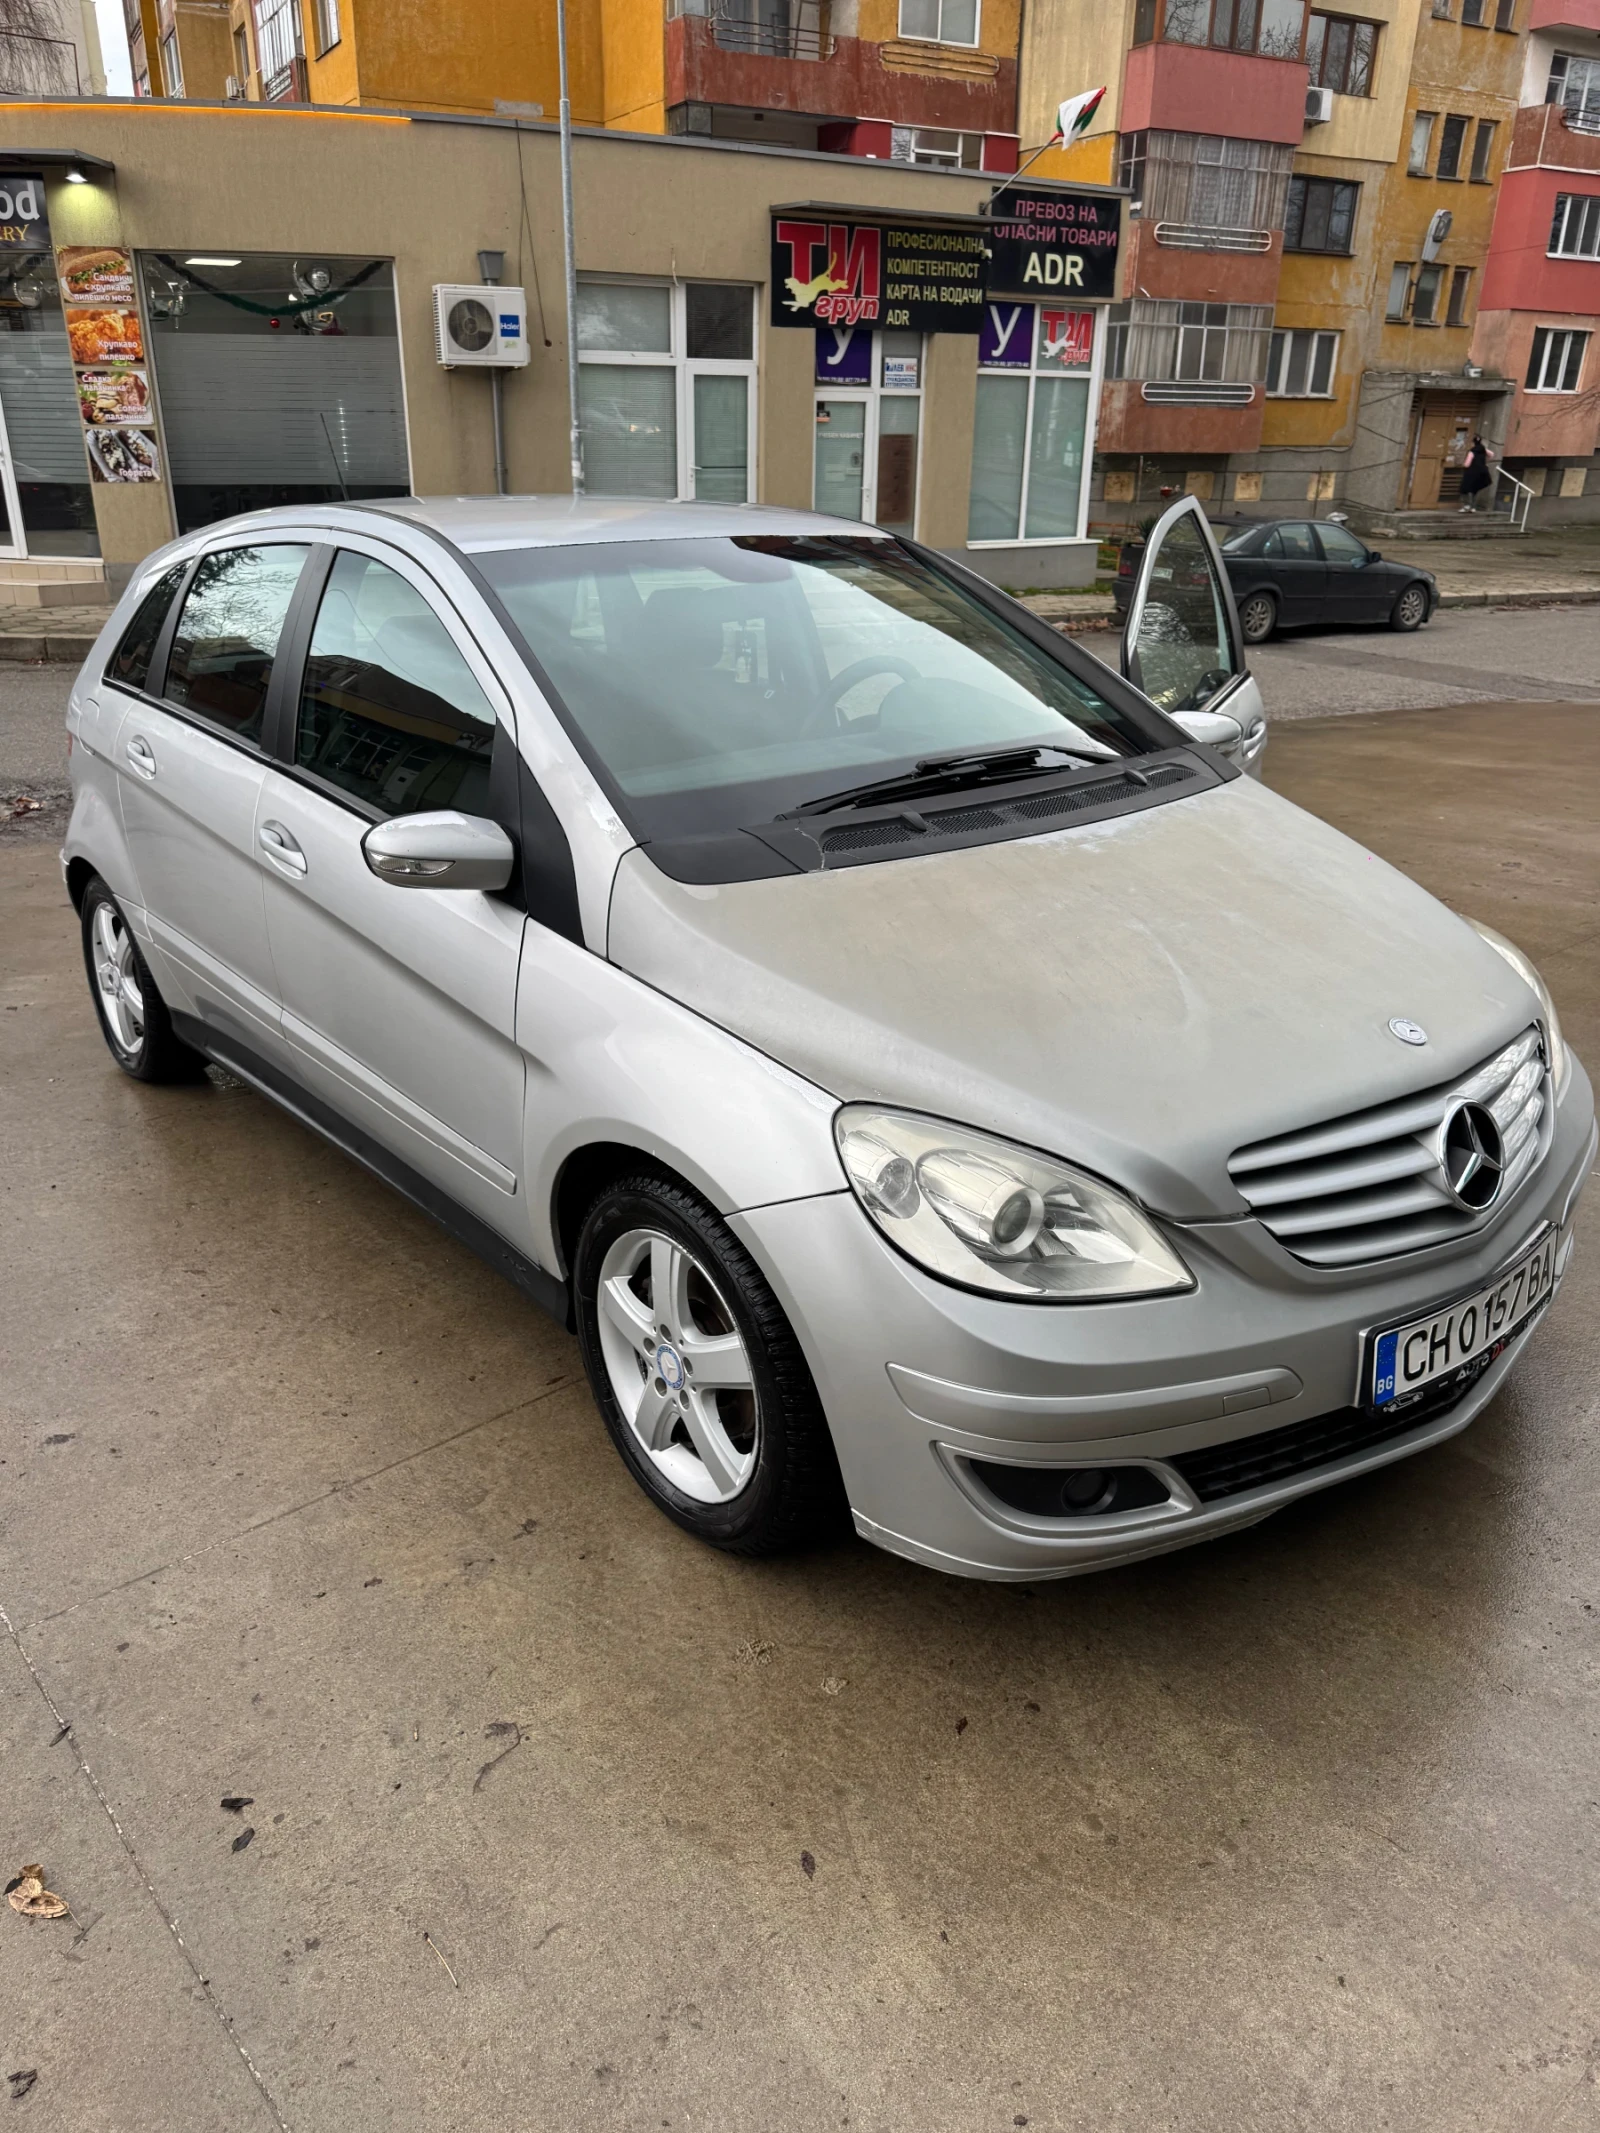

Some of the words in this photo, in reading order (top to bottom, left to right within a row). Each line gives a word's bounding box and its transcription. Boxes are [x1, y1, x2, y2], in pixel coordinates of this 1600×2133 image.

[1015, 200, 1075, 221] ПРЕВОЗ
[1078, 206, 1098, 222] НА
[0, 223, 30, 242] RY
[887, 231, 985, 251] ПРОФЕСИОНАЛНА
[1060, 227, 1118, 247] ТОВАРИ
[777, 220, 881, 298] ТИ
[886, 258, 980, 279] КОМПЕТЕНТНОСТ
[1023, 252, 1084, 287] ADR
[886, 284, 920, 301] КАРТА
[922, 287, 938, 302] НА
[941, 287, 983, 306] ВОДАЧИ
[500, 322, 520, 330] Haier
[886, 309, 910, 326] ADR
[1042, 309, 1094, 352] ТИ
[1458, 1267, 1526, 1354] 0157
[1376, 1374, 1394, 1394] BG
